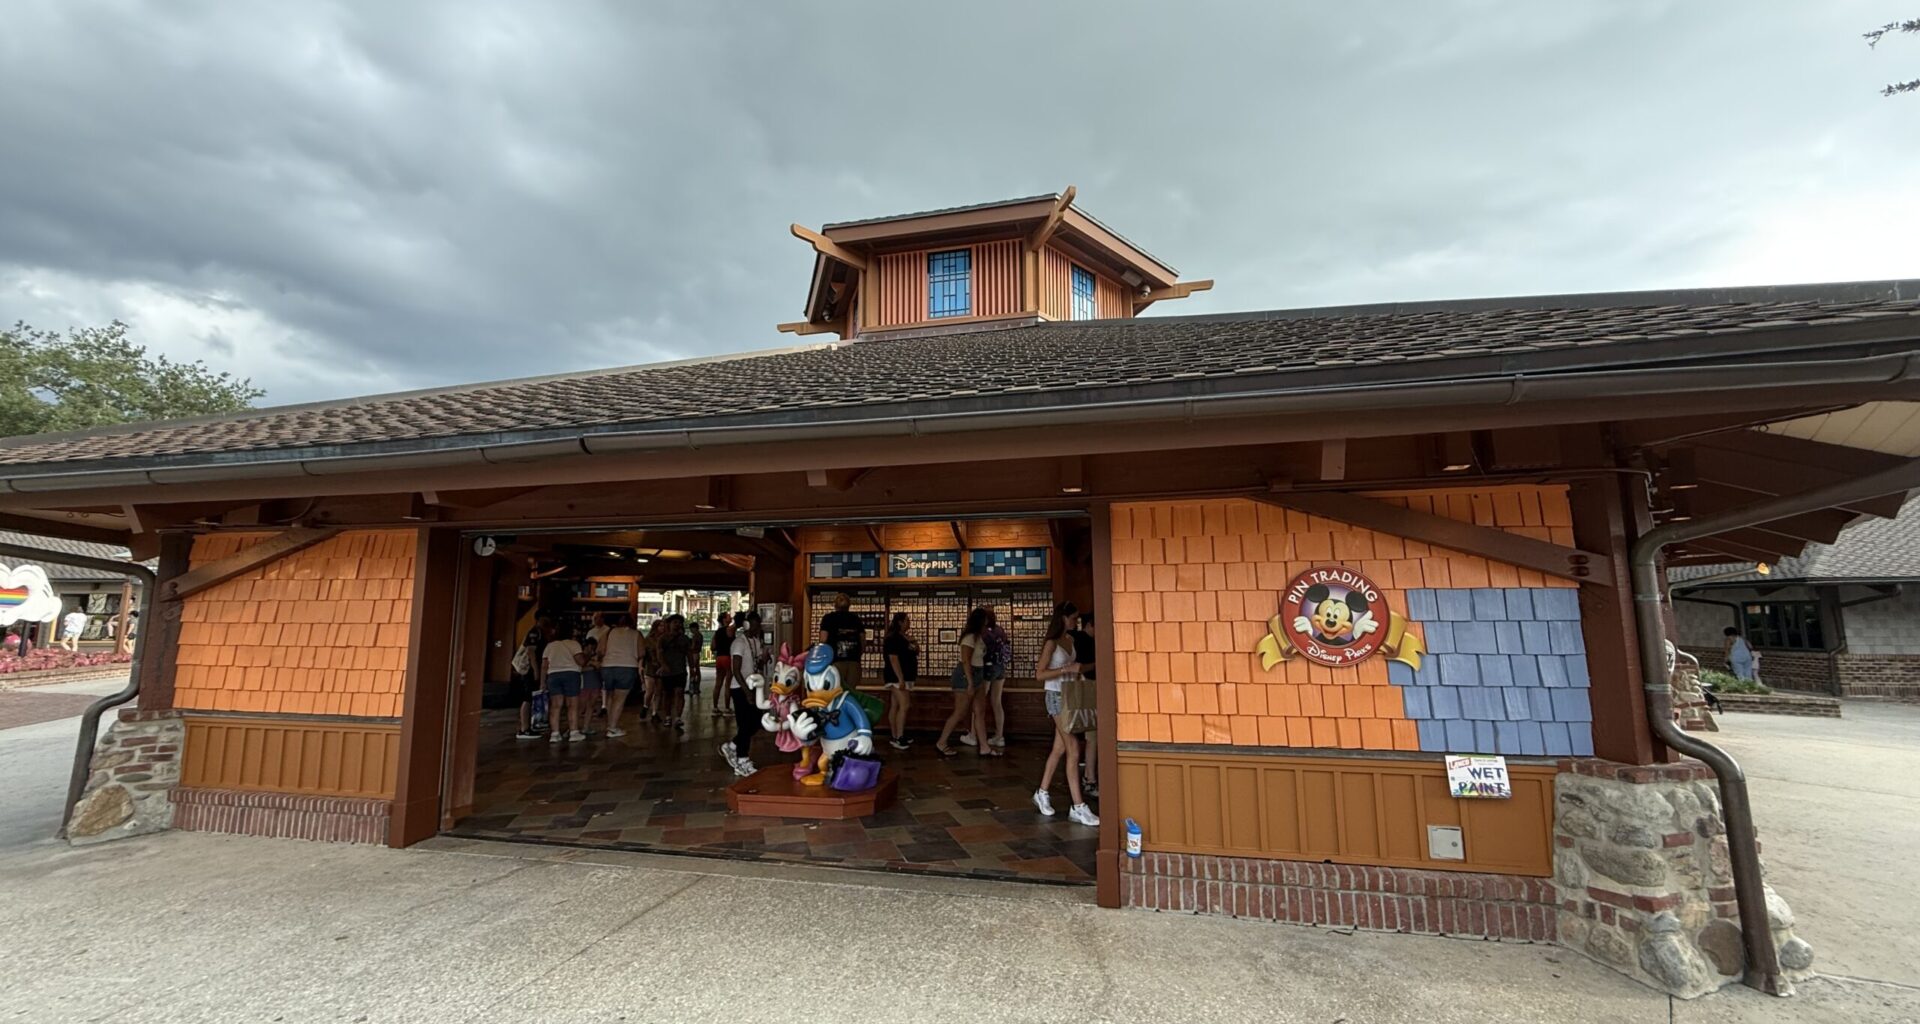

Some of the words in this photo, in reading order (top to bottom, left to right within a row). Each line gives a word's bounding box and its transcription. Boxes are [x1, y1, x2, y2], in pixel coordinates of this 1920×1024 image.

[891, 556, 931, 573] Disney
[932, 560, 955, 569] PINS
[1288, 579, 1310, 605] PIN
[1310, 570, 1378, 603] TRADING
[1306, 640, 1343, 664] Disney
[1344, 643, 1373, 660] Parks
[1467, 767, 1504, 780] WET
[1458, 781, 1506, 794] PAINT
